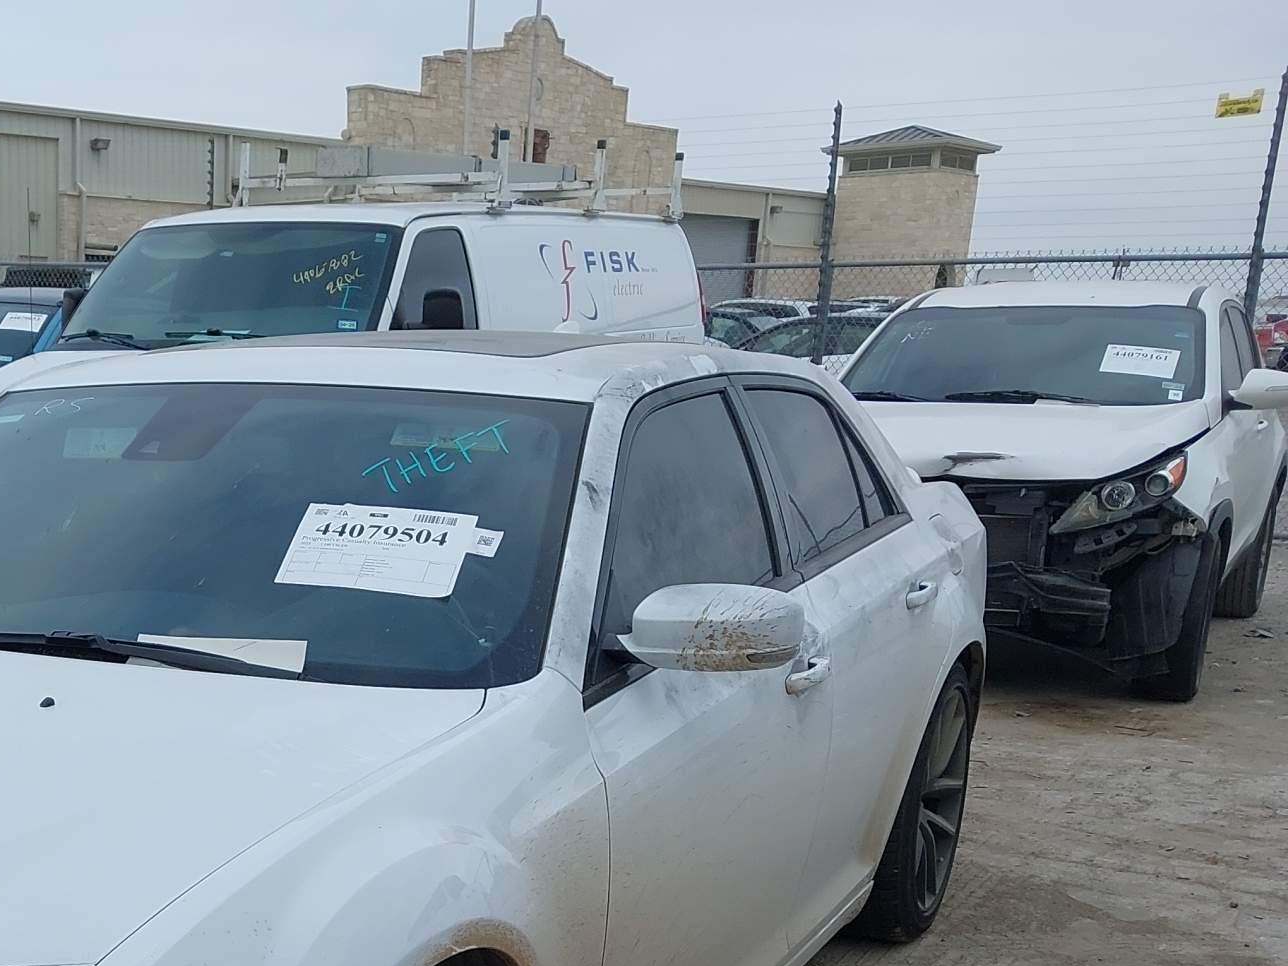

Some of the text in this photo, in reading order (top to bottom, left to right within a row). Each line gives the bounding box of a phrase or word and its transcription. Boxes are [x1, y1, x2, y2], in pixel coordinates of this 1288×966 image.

[584, 251, 640, 273] FISK
[1113, 350, 1169, 361] 44079161
[362, 418, 510, 493] THEFT
[315, 521, 449, 547] 44079504
